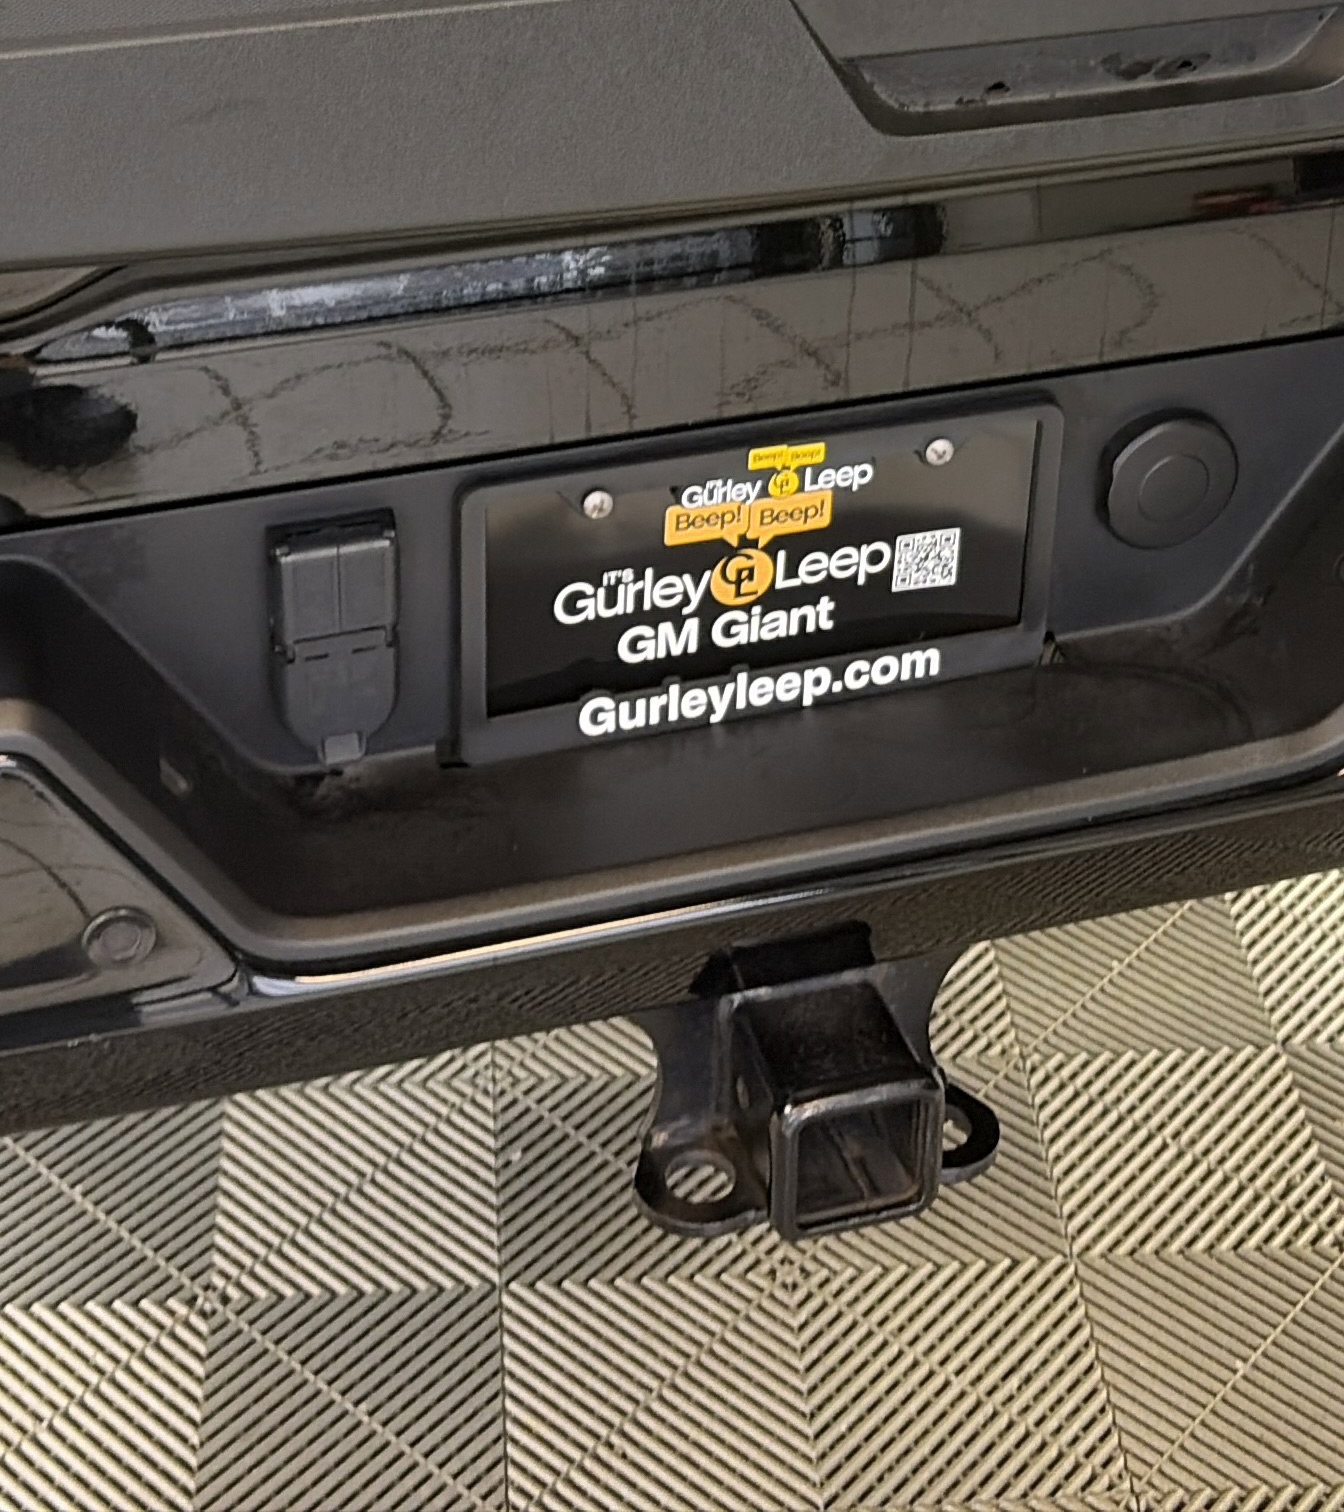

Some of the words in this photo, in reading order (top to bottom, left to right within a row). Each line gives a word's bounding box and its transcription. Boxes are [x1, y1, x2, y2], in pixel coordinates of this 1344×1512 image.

[804, 462, 875, 492] Leep
[675, 504, 742, 532] Beep!
[759, 498, 825, 526] Beep!
[553, 566, 712, 625] Gurley
[774, 539, 892, 590] Leep
[617, 617, 700, 664] GM
[711, 595, 836, 649] Giant
[578, 646, 941, 737] Gurleyleep.com
